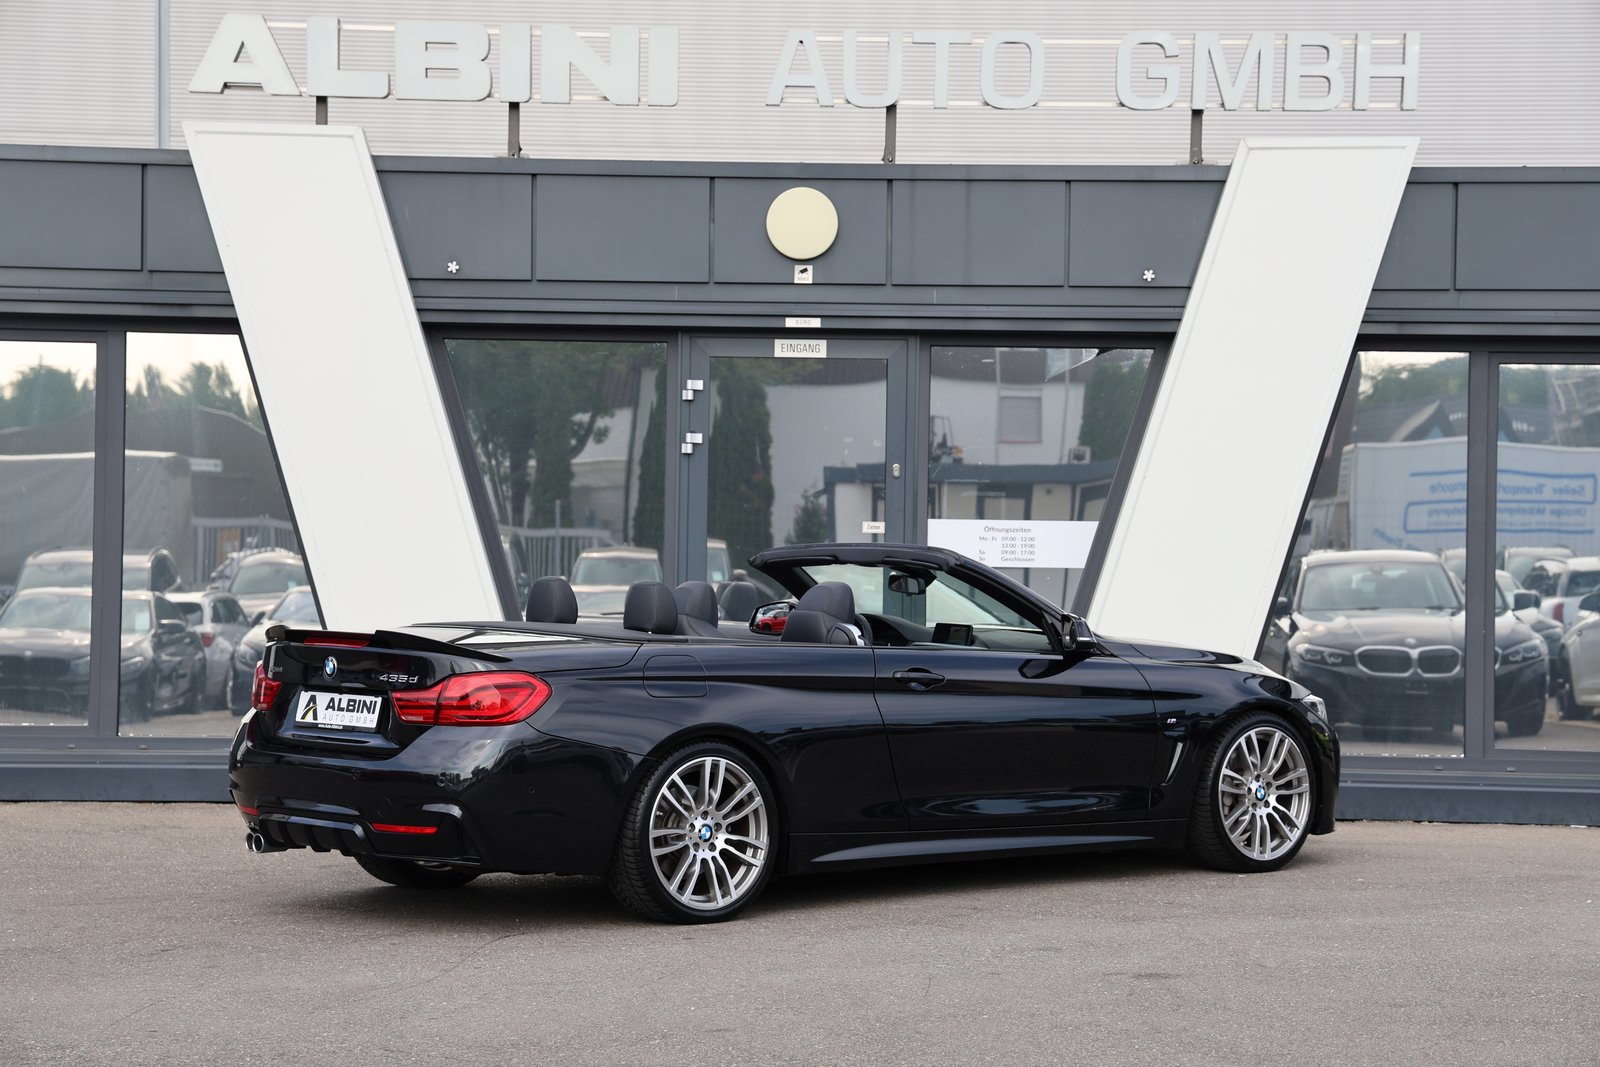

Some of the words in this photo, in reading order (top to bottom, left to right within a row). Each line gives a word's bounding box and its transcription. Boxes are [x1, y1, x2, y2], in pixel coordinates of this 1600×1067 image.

[188, 13, 679, 107] ALBINI
[765, 28, 1045, 110] AUTO
[1114, 30, 1420, 112] GMBH
[780, 343, 821, 353] EINGANG
[984, 525, 1032, 534] Öffnungszeiten
[380, 673, 419, 683] 435d
[325, 697, 378, 715] ALBINI
[322, 713, 346, 722] AUTO
[349, 715, 375, 724] GMBH
